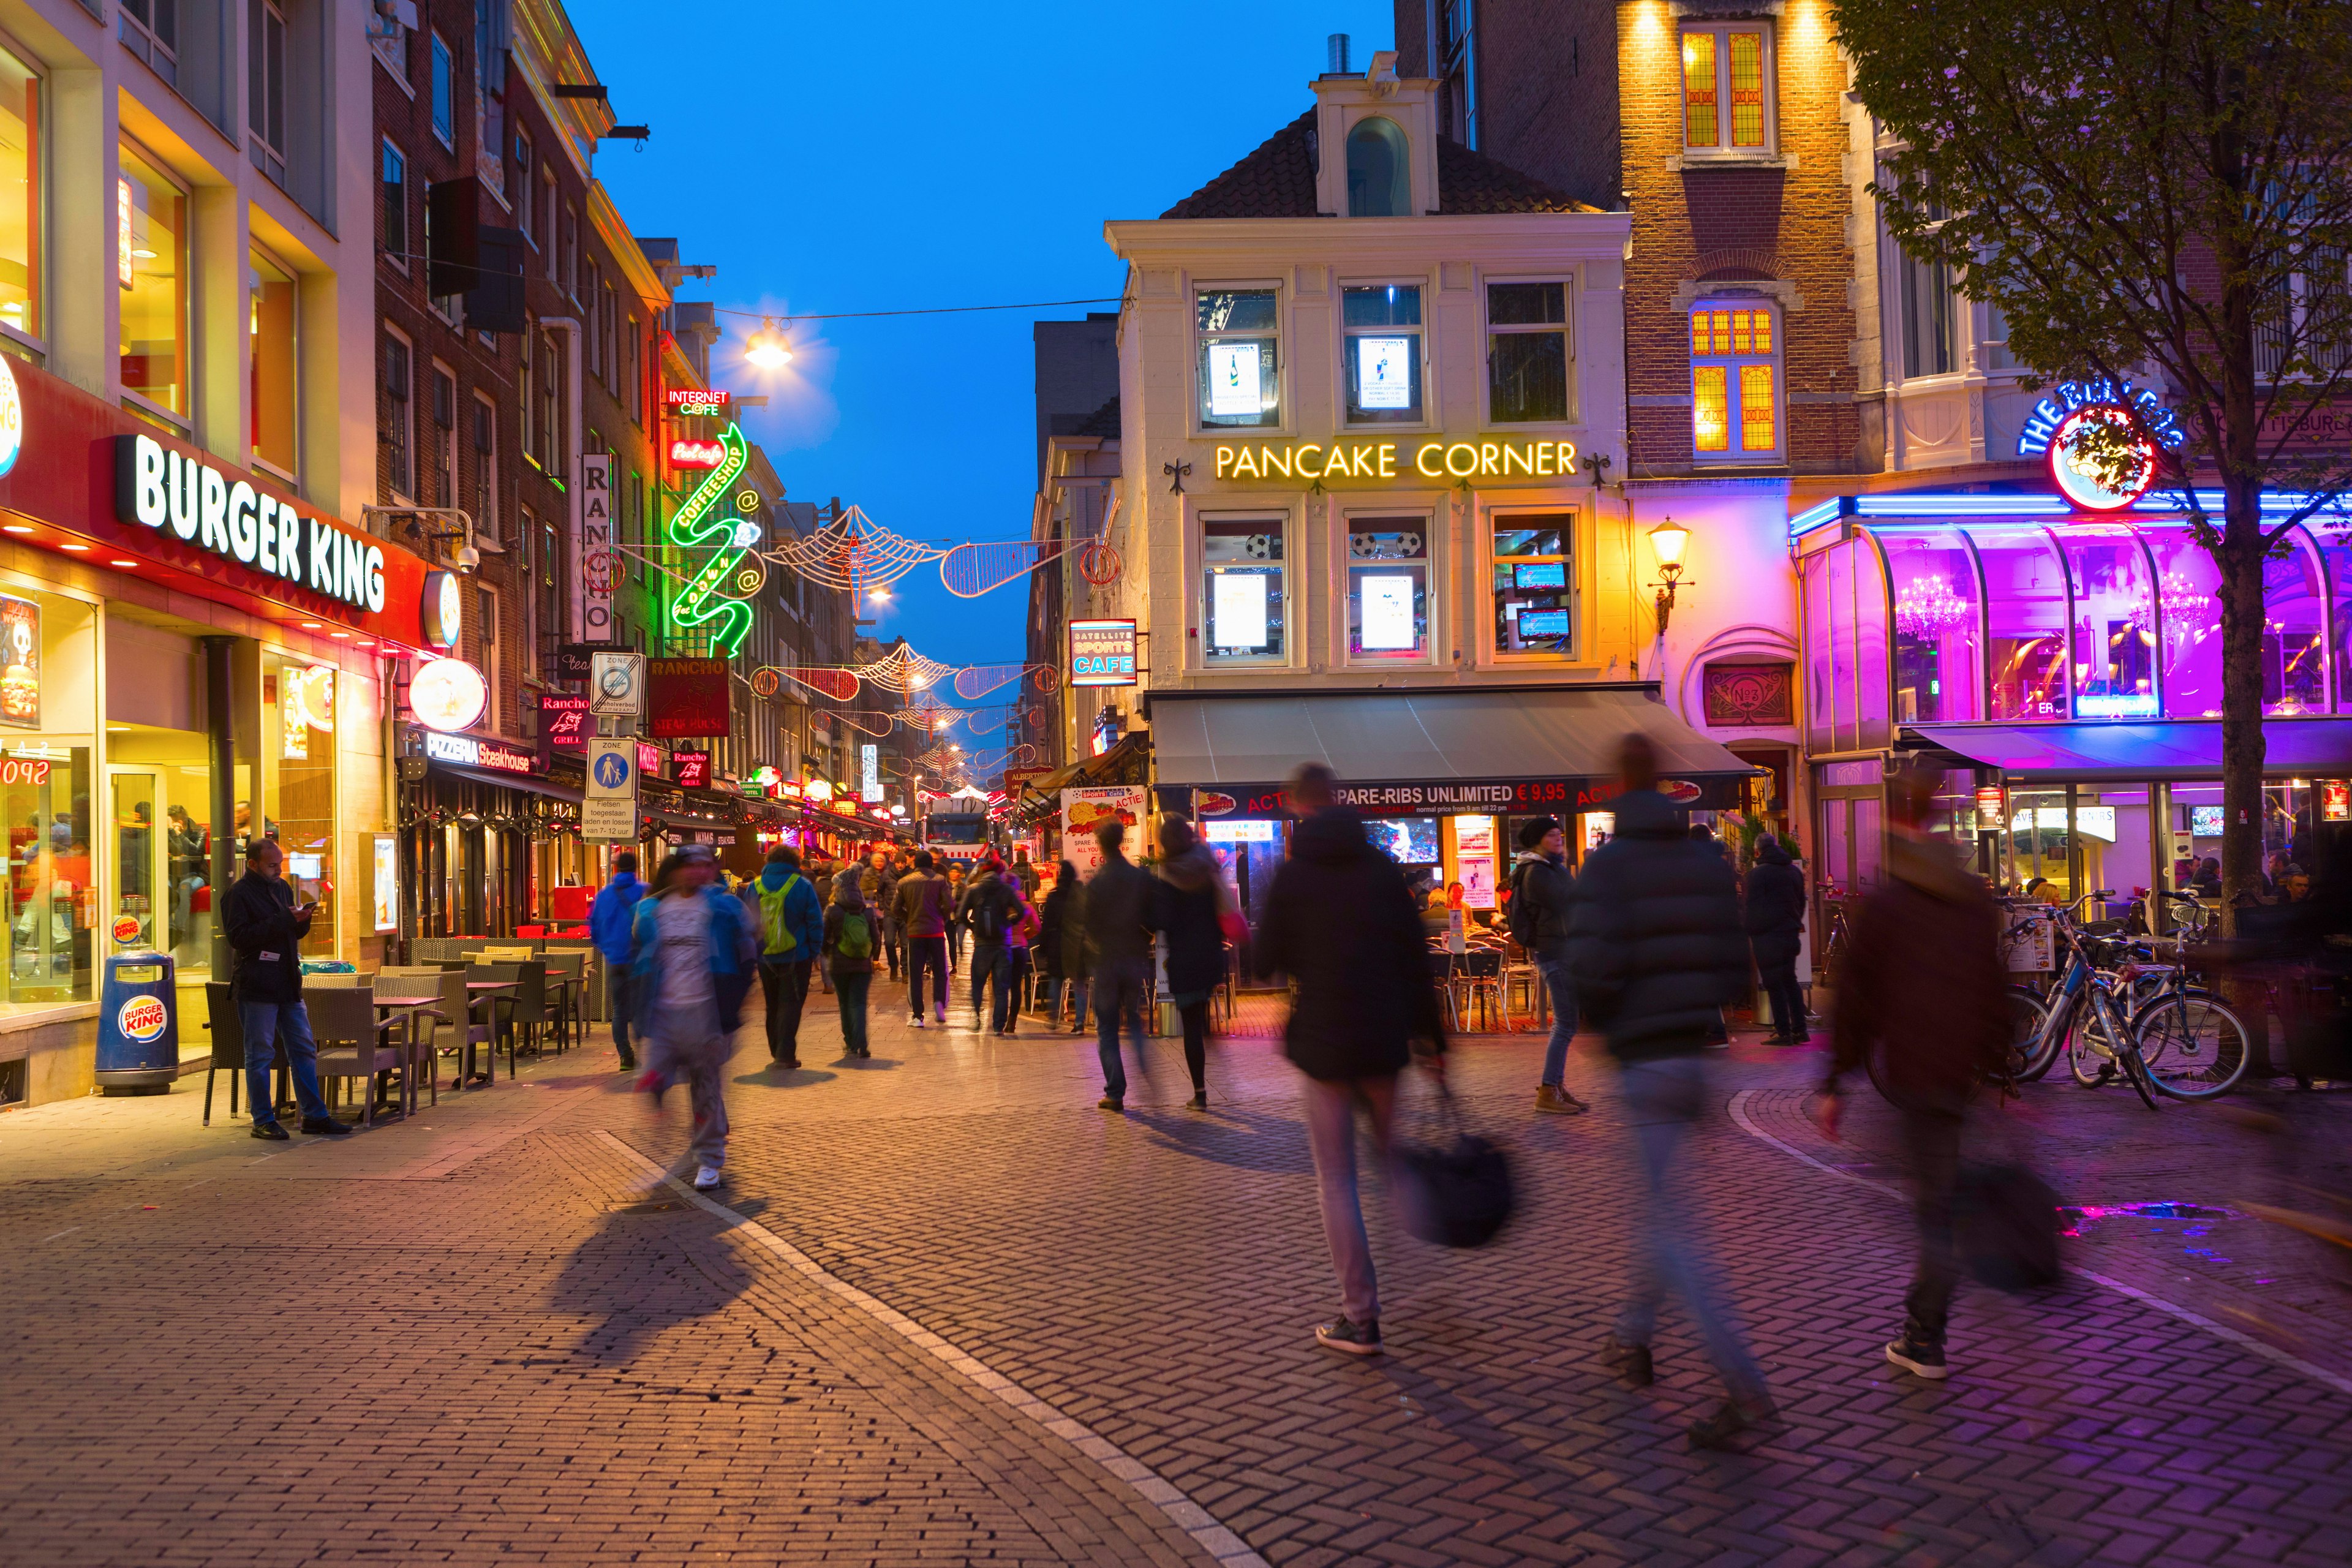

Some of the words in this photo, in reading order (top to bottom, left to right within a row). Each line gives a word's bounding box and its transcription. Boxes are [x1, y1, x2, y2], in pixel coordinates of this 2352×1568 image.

[669, 391, 727, 404] INTERNET
[2017, 398, 2064, 454] THE
[673, 443, 697, 460] Pool
[1215, 443, 1396, 480] PANCAKE
[1416, 441, 1577, 477] CORNER
[677, 447, 742, 527] COFFEESHOP
[135, 434, 301, 582] BURGER
[310, 518, 385, 613] KING
[586, 467, 609, 627] RANCHO
[1073, 640, 1134, 654] SPORTS
[652, 662, 724, 675] RANCHO
[1074, 656, 1134, 674] CAFE
[542, 697, 589, 709] Rancho
[655, 718, 685, 730] STEAK
[554, 736, 582, 744] GRILL
[428, 732, 479, 764] PIZZERIA
[478, 742, 529, 772] Steakhouse
[674, 753, 707, 761] Rancho
[865, 747, 875, 800] RANCHO
[1427, 786, 1513, 803] UNLIMITED
[1516, 784, 1528, 801] €
[1532, 783, 1566, 804] 9,95
[1116, 794, 1145, 809] ACTIE!
[2325, 804, 2348, 812] KARAOKE
[695, 832, 714, 845] MAXIMUS
[1090, 856, 1096, 867] €
[115, 920, 137, 932] BURGER
[115, 925, 138, 939] KING
[125, 1004, 162, 1021] BURGER
[126, 1012, 164, 1033] KING
